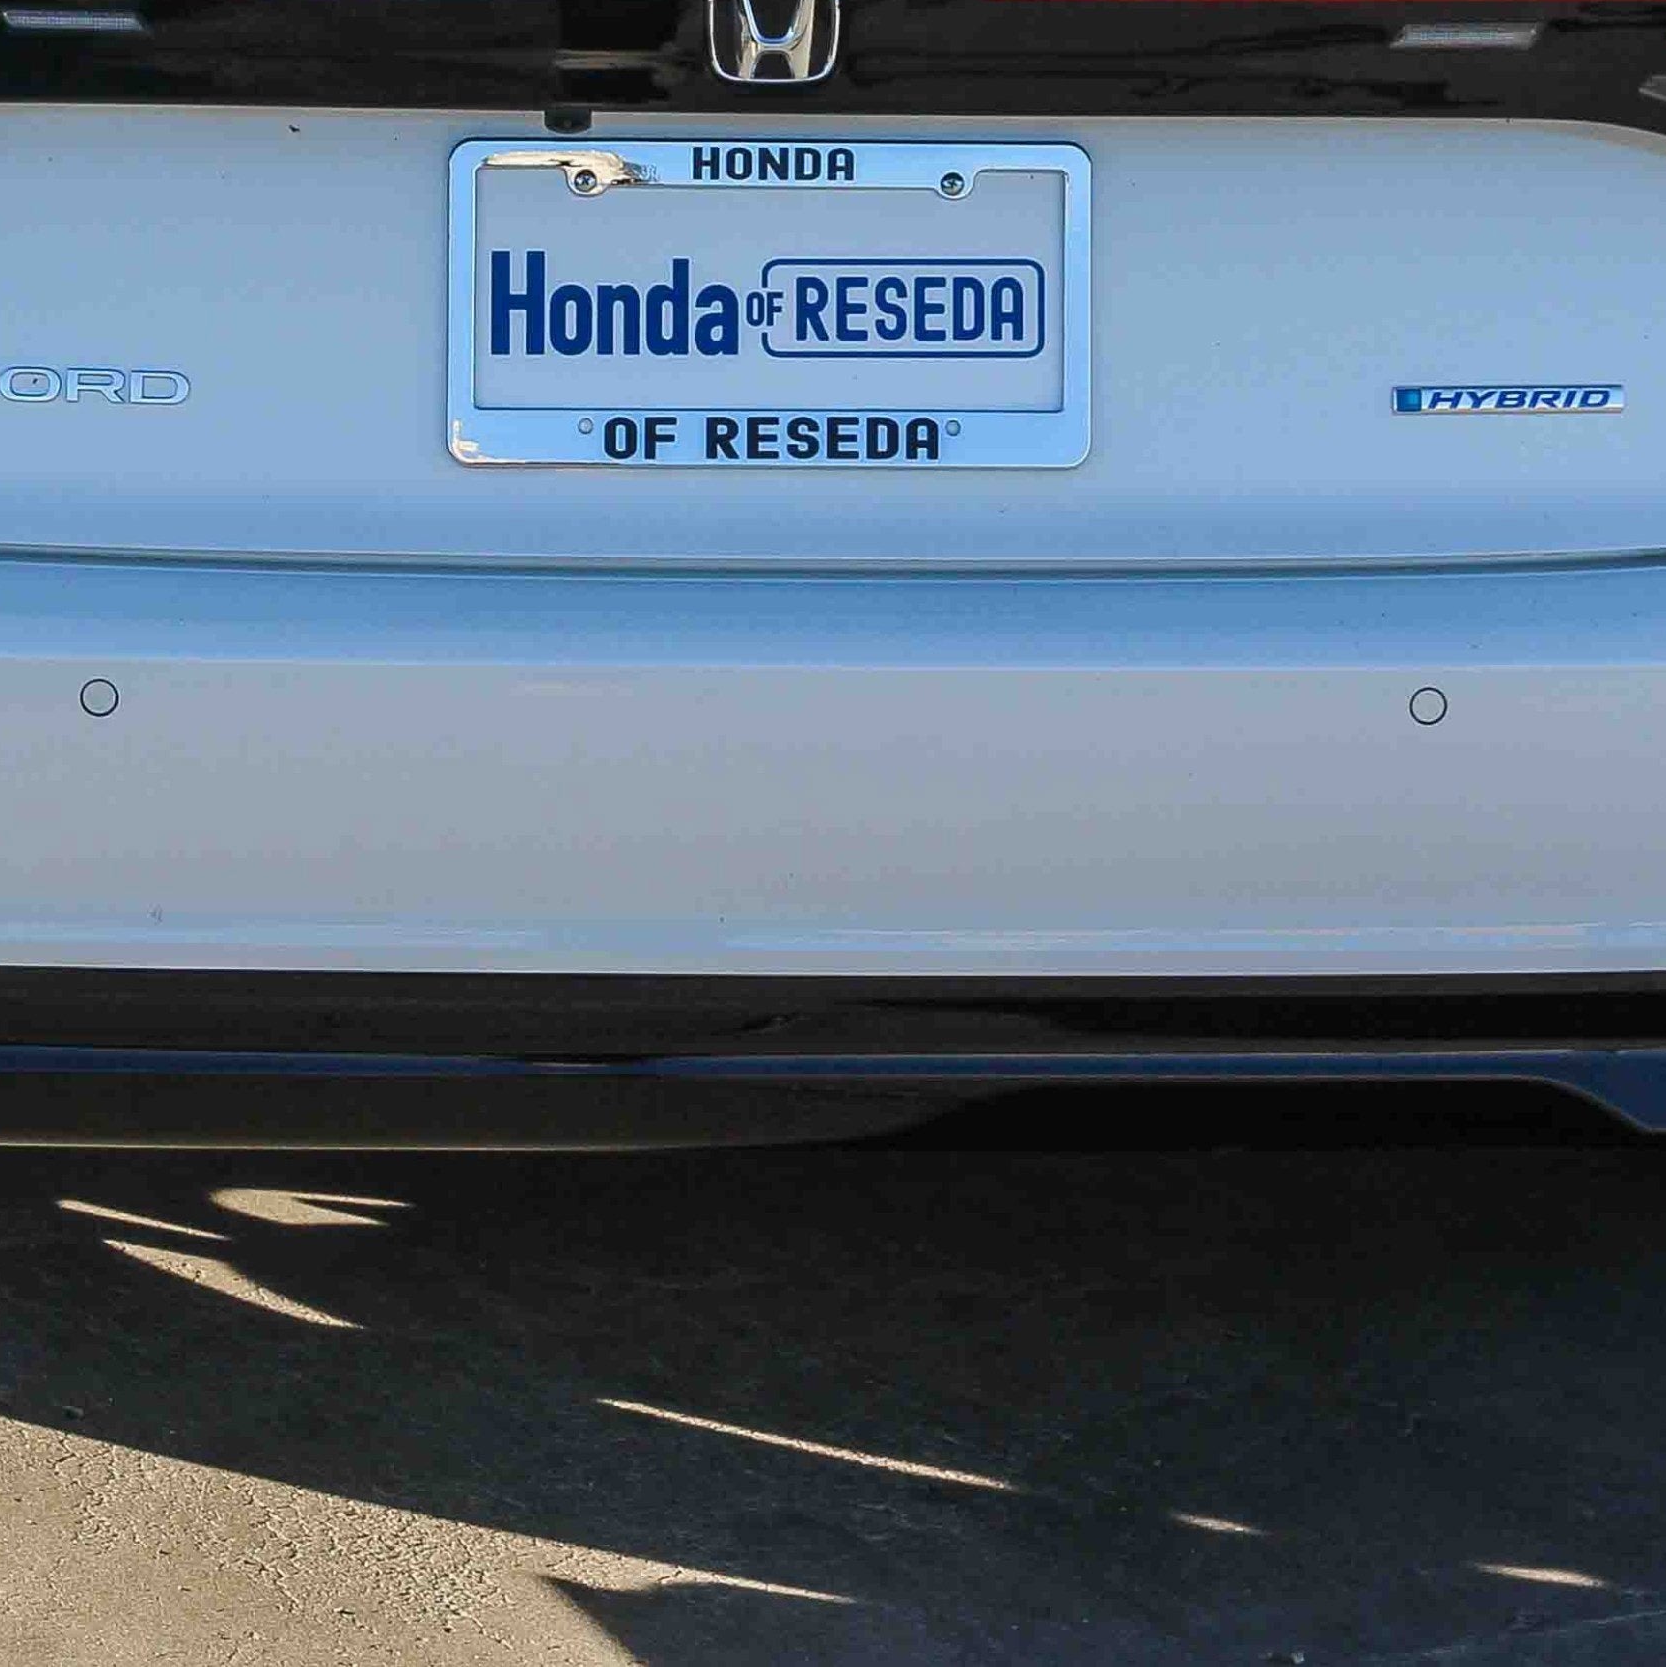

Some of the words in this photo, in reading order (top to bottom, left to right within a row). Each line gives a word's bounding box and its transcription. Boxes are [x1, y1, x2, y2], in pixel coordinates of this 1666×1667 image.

[693, 146, 854, 181] HONDA
[490, 250, 739, 356] Honda
[746, 291, 783, 327] OF
[795, 276, 1024, 342] RESEDA
[1428, 389, 1610, 409] HYBRID
[603, 416, 677, 460] OF
[705, 416, 939, 460] RESEDA
